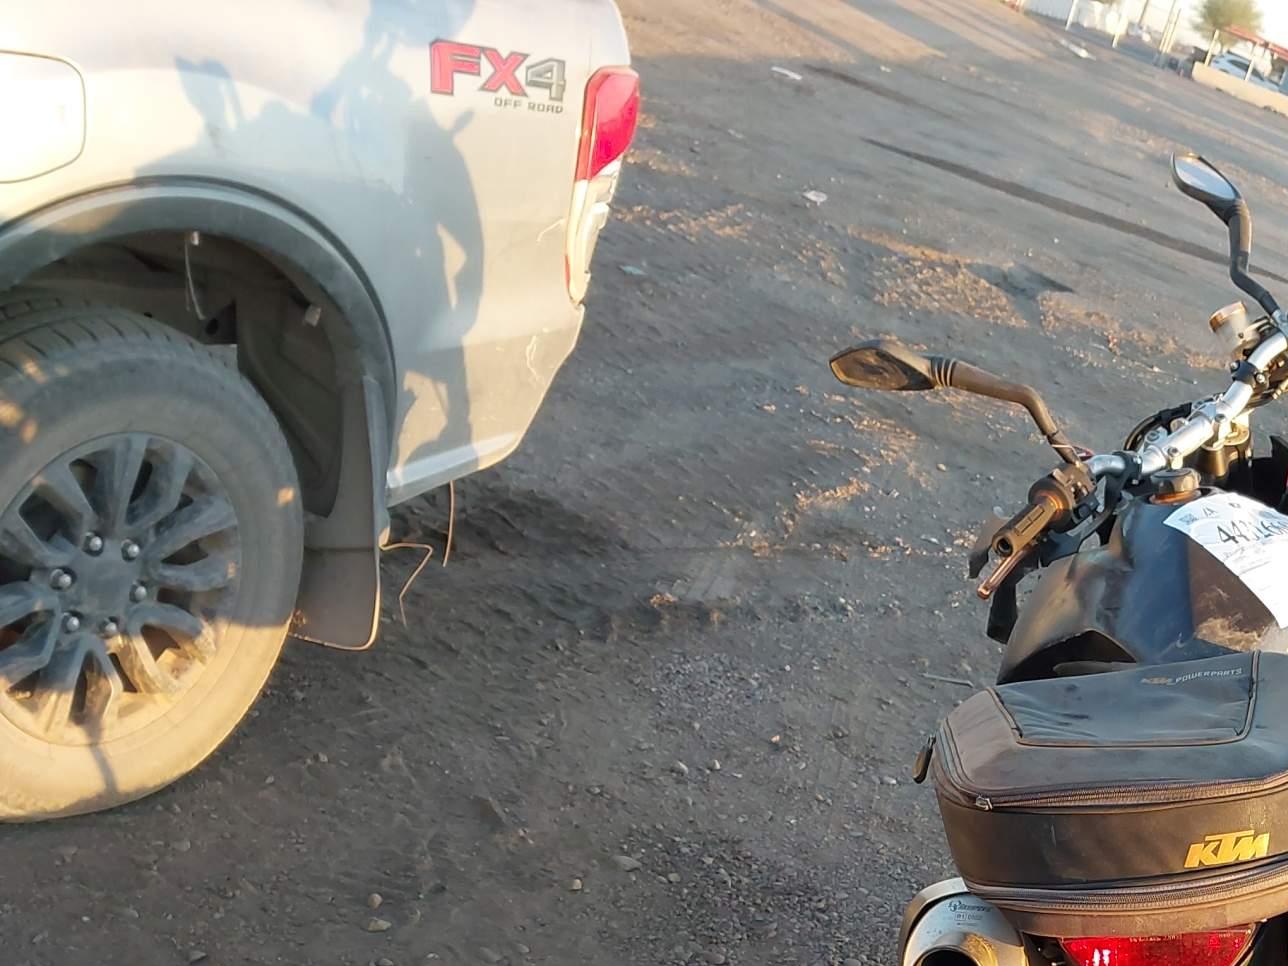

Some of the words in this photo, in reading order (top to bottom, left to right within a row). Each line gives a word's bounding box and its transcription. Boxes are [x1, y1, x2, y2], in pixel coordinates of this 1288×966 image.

[429, 38, 566, 103] FX4
[493, 97, 522, 109] OFF
[527, 102, 564, 114] ROAD
[1176, 668, 1242, 683] POWERPARTS
[1183, 829, 1270, 868] KTM
